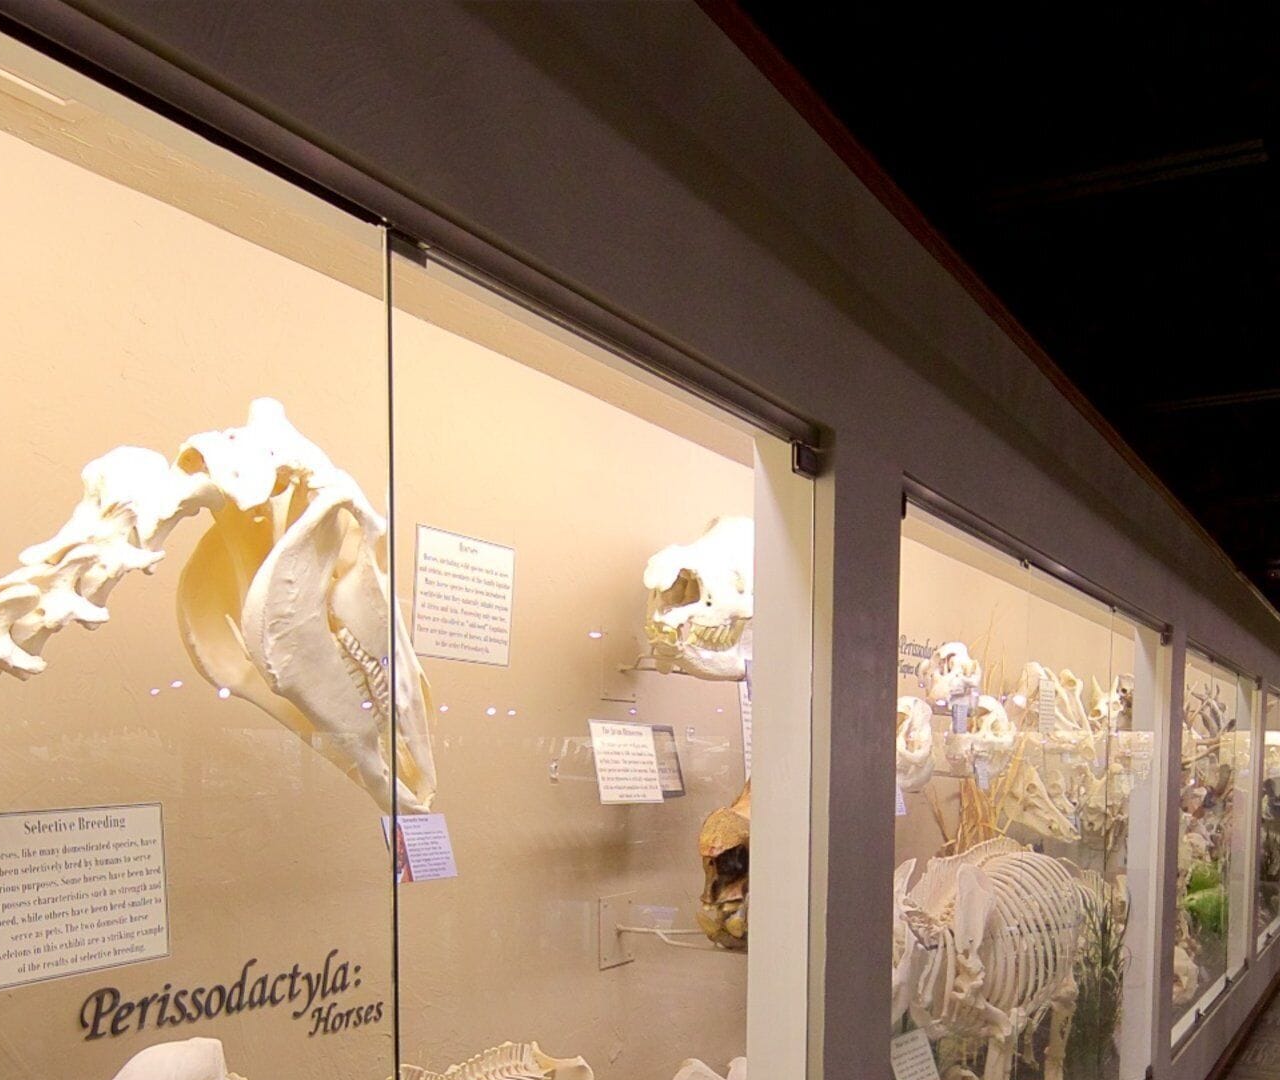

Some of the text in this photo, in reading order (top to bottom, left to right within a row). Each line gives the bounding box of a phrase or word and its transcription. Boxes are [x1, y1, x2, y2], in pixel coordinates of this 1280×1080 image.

[24, 816, 125, 833] Selective Breeding
[21, 849, 37, 857] like
[61, 841, 110, 854] domesticated
[20, 862, 61, 873] selectively
[64, 860, 82, 869] bred
[94, 857, 122, 866] humans
[60, 877, 81, 885] Some
[82, 874, 106, 883] horses
[126, 869, 144, 877] been
[144, 866, 160, 875] bred
[1, 900, 31, 911] possess
[32, 892, 89, 905] characteristics
[148, 881, 161, 890] and
[20, 913, 42, 922] while
[44, 910, 69, 920] others
[70, 908, 88, 916] have
[90, 904, 108, 913] been
[109, 900, 125, 910] bred
[10, 932, 32, 941] serve
[64, 924, 79, 933] The
[96, 917, 127, 928] domestic
[129, 914, 148, 922] horse
[42, 944, 57, 952] this
[106, 931, 134, 941] striking
[136, 925, 163, 936] example
[27, 962, 40, 971] the
[79, 950, 111, 960] selective
[80, 948, 362, 1042] Perissodactyla:
[308, 1001, 384, 1037] Horses
